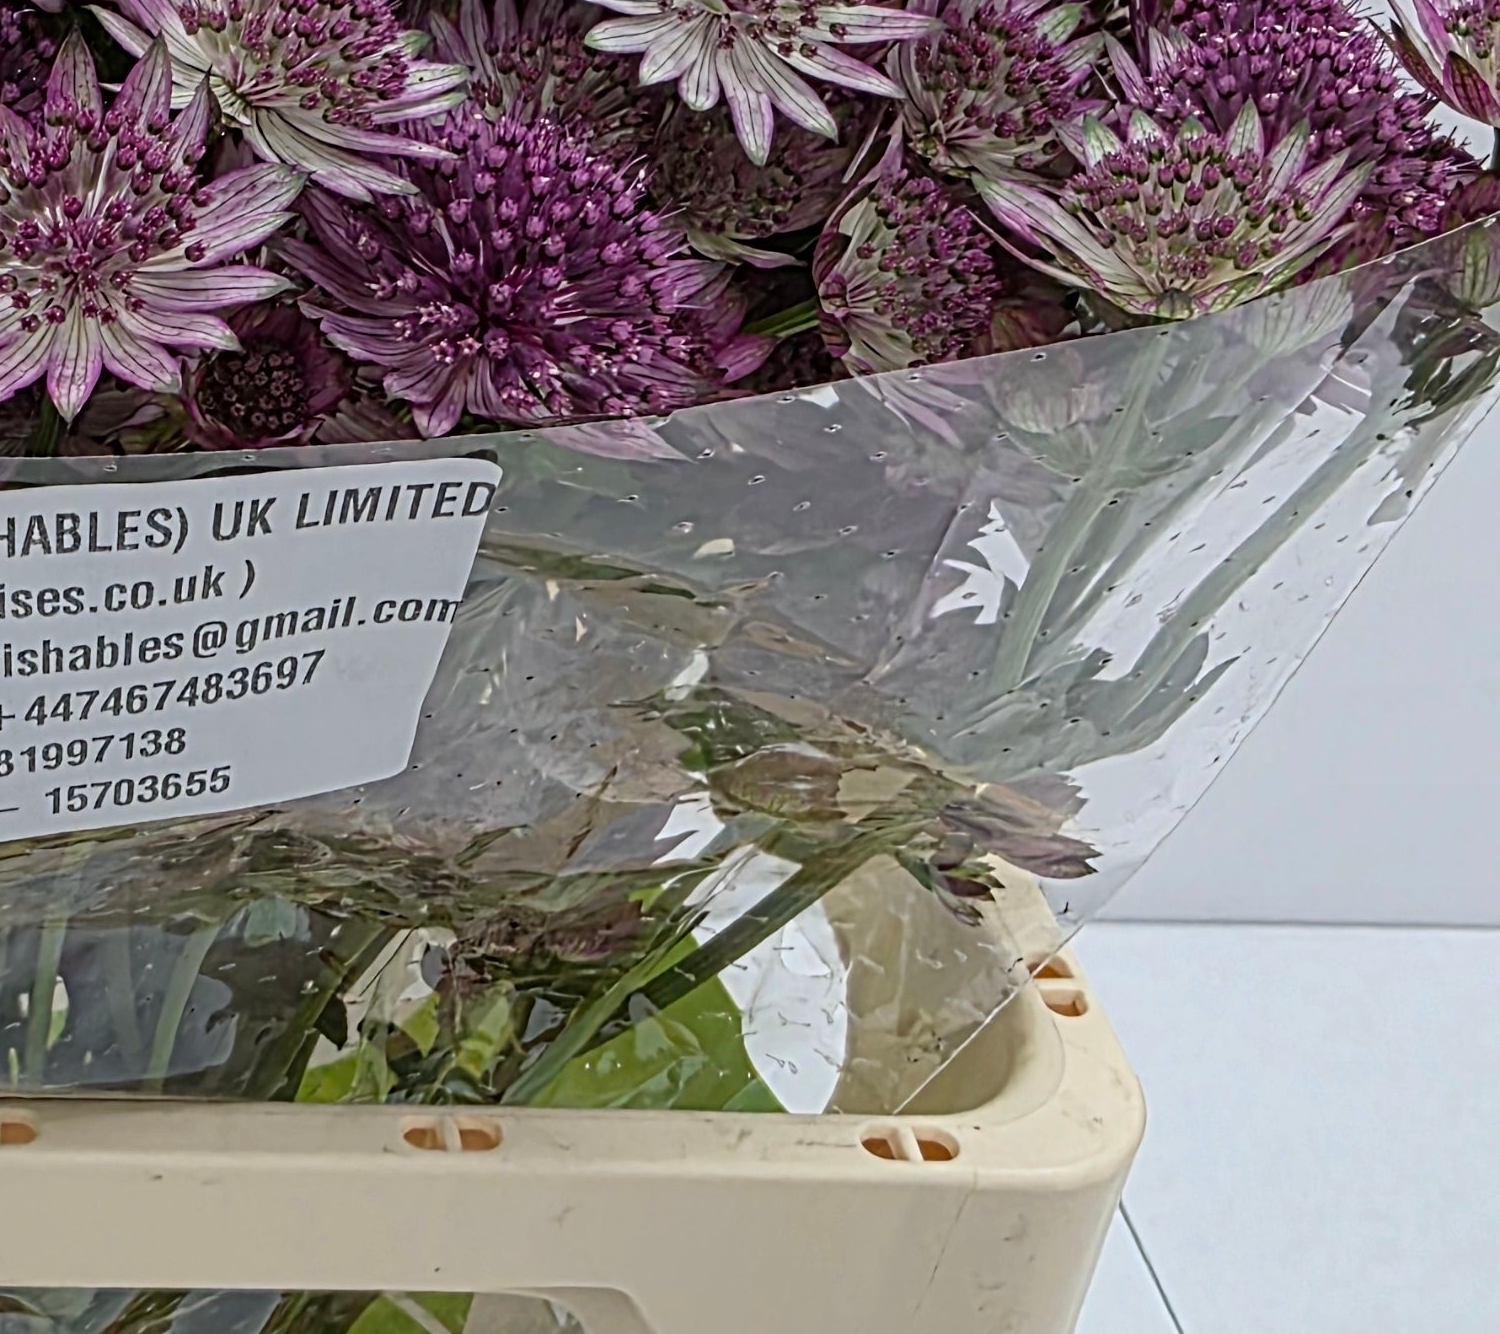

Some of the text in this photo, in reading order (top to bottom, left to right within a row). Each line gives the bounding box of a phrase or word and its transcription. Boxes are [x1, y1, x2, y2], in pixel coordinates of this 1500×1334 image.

[211, 497, 277, 542] UK
[294, 480, 495, 530] LIMITED
[237, 559, 256, 599] )
[45, 765, 231, 816] 15703655
